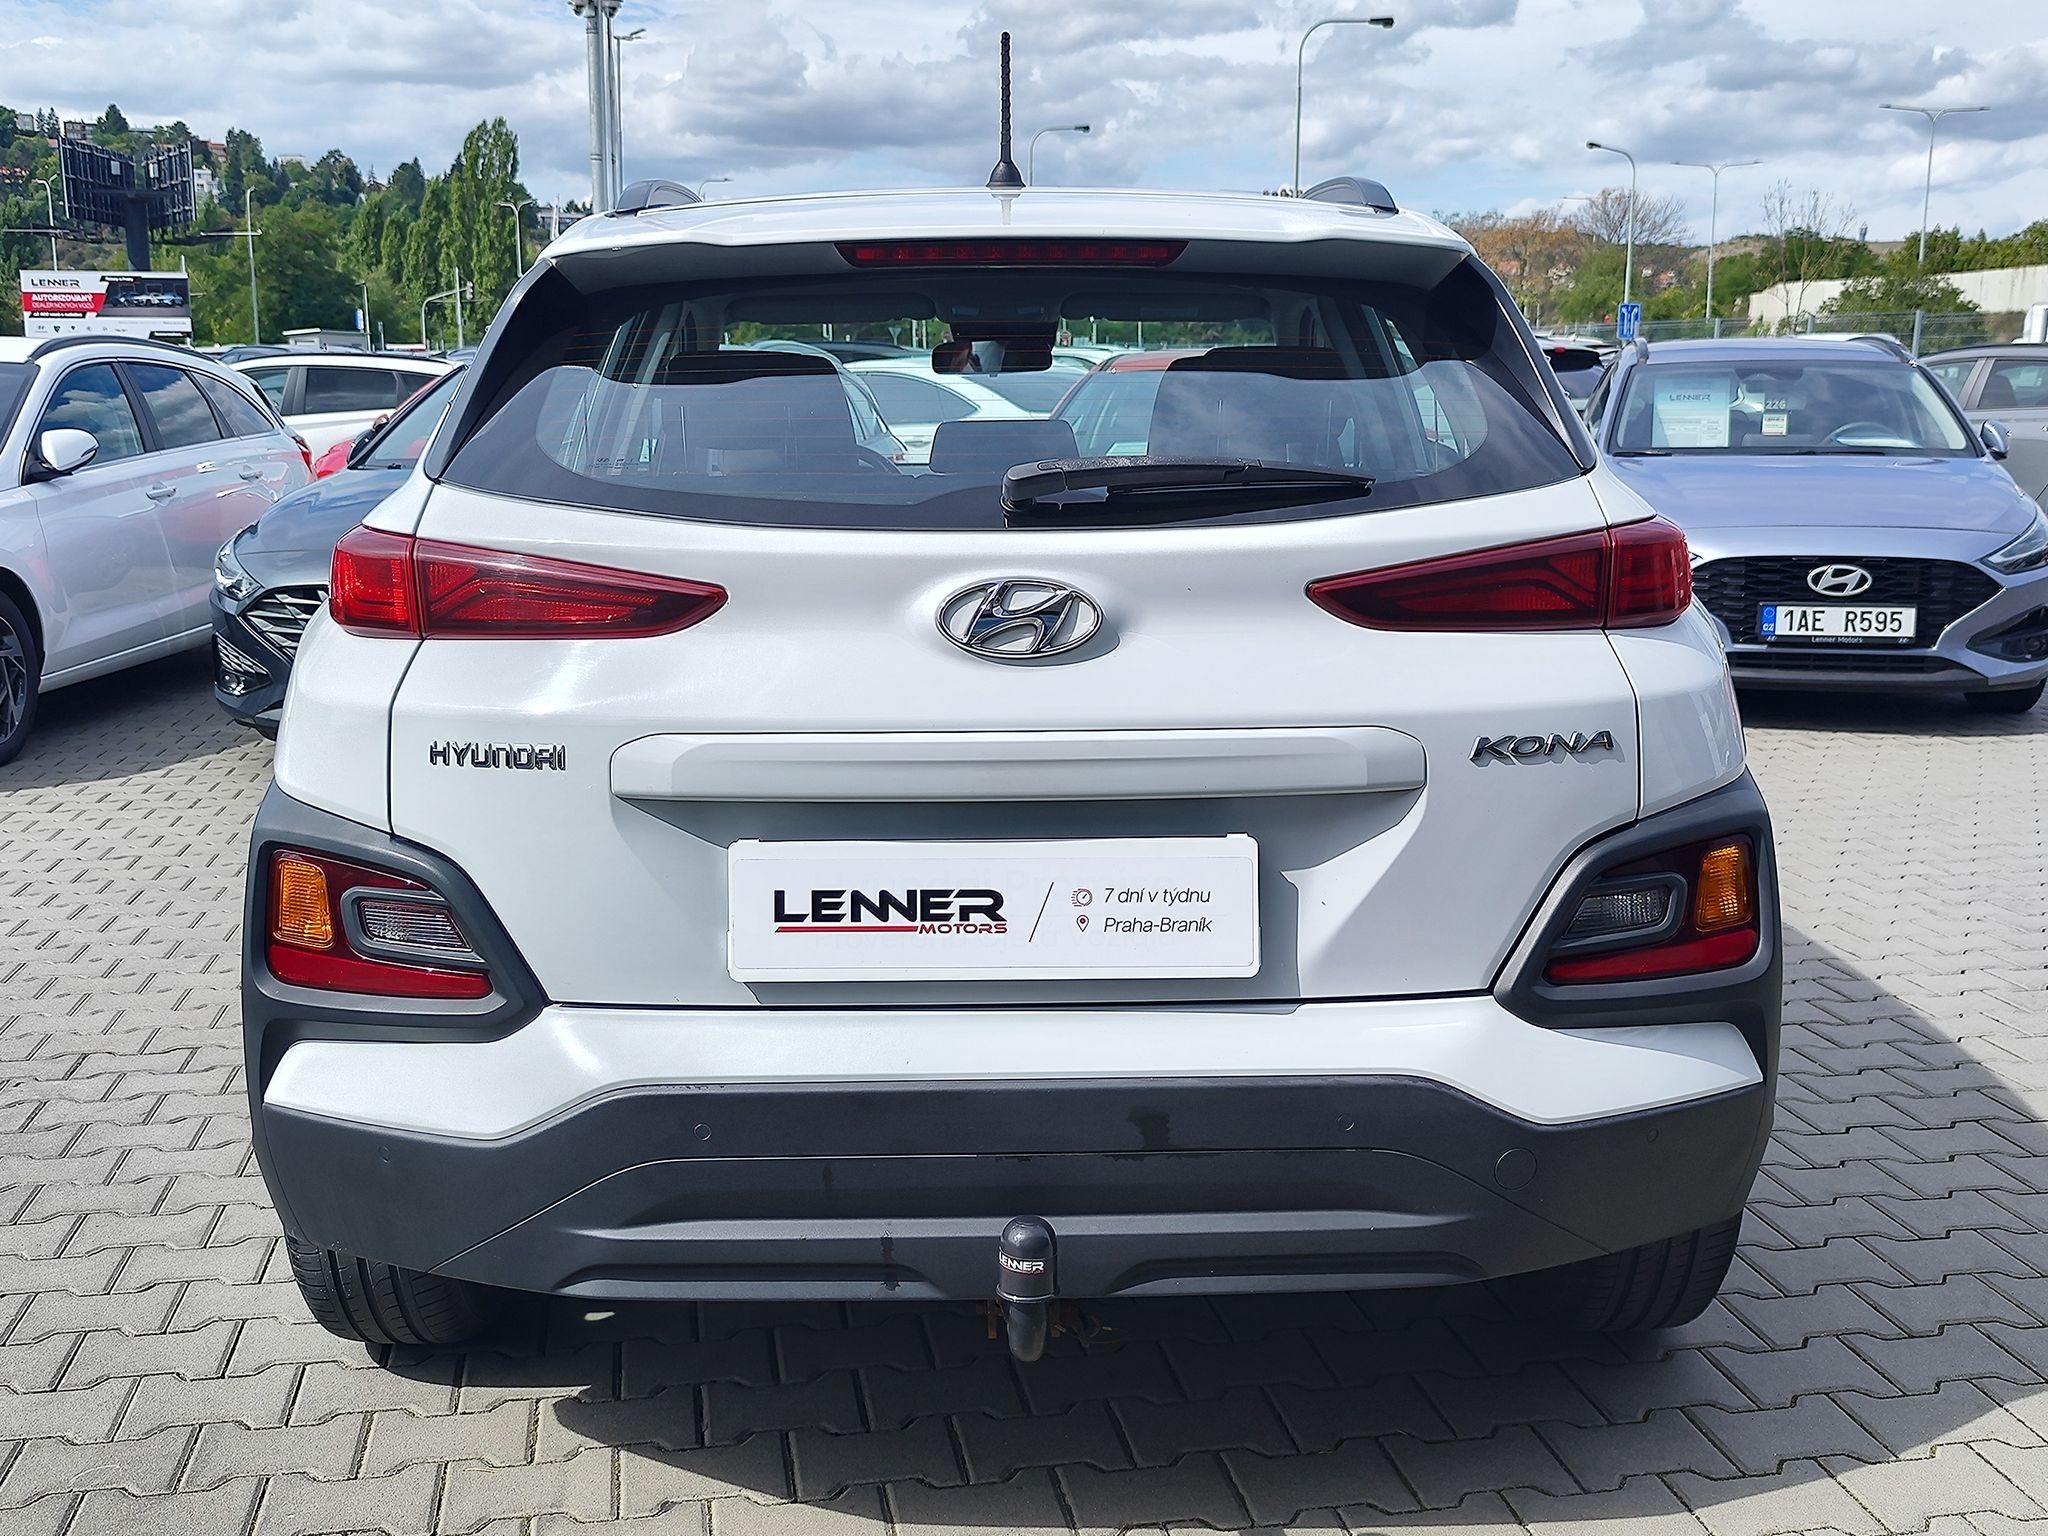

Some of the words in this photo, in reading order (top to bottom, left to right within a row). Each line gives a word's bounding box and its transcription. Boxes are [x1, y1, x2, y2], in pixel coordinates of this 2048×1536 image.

[31, 278, 80, 287] LENNER
[1668, 393, 1711, 401] LENNER
[1783, 609, 1826, 632] 1AE
[1844, 610, 1903, 633] R595
[430, 740, 567, 771] HYUNDAI
[1469, 730, 1615, 762] KONA
[774, 889, 1008, 923] LENNER
[1104, 887, 1115, 903] 7
[1117, 887, 1146, 904] dní
[1148, 890, 1159, 903] v
[1163, 887, 1212, 907] týdnu
[919, 923, 1008, 935] MOTORS
[1103, 916, 1213, 933] Praha-Braník
[999, 1250, 1045, 1272] LENNER
